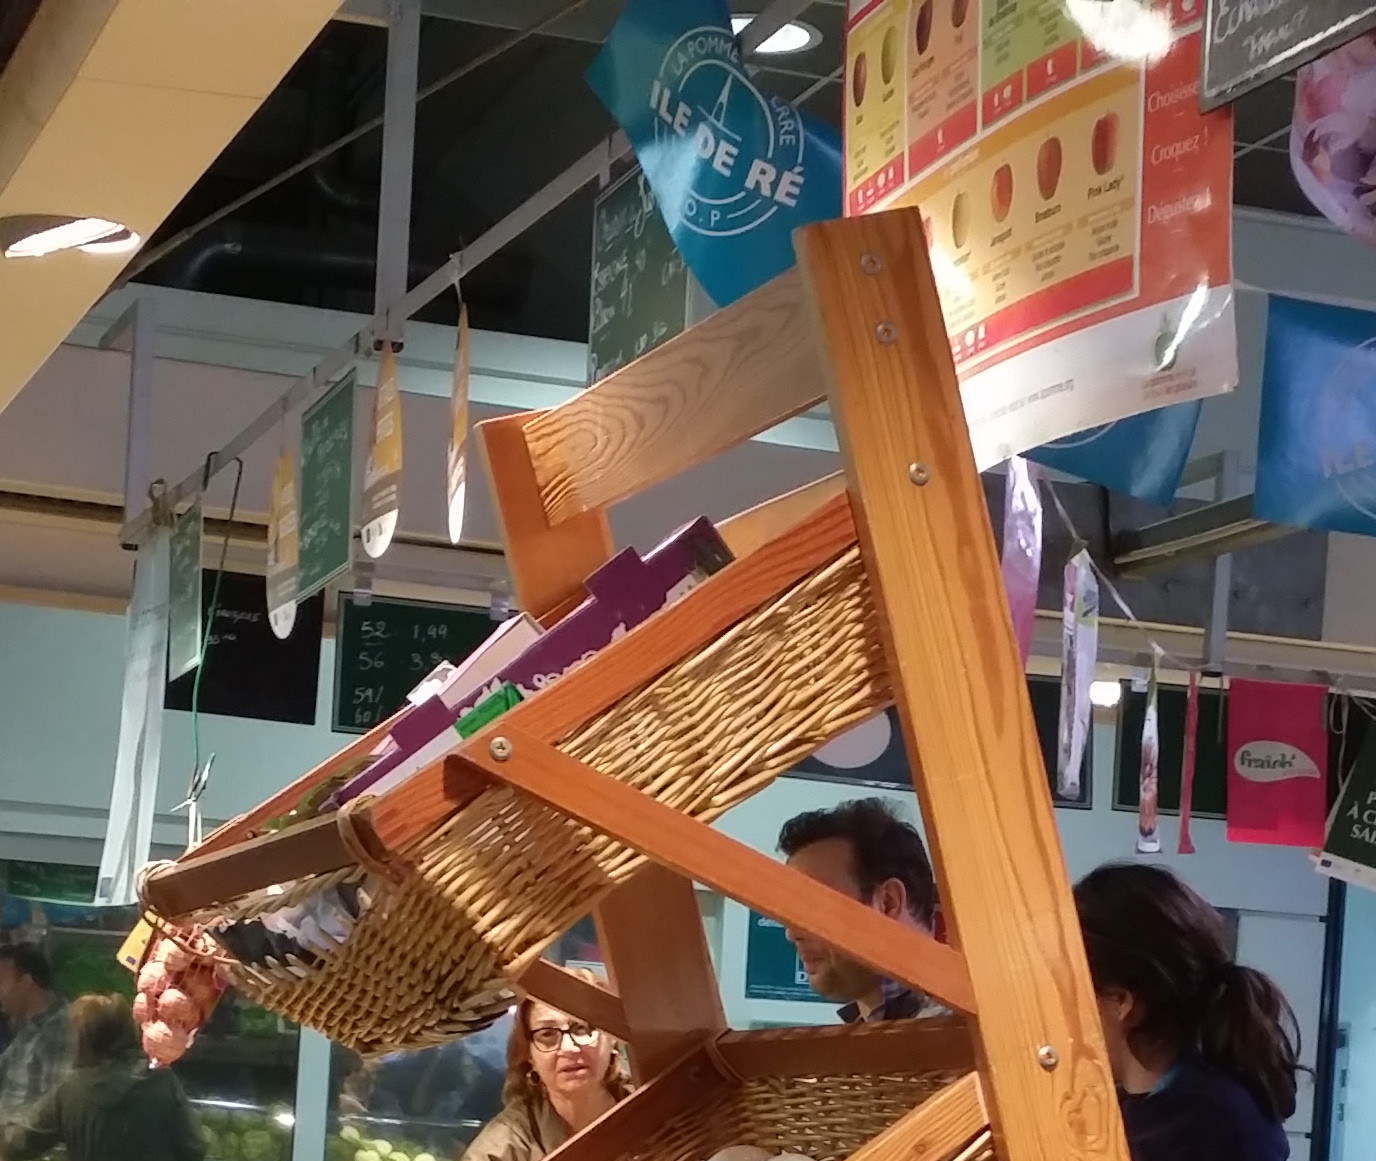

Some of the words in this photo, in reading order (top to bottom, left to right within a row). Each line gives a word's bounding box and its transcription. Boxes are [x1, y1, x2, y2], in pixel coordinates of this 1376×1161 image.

[650, 80, 693, 138] ILE
[694, 121, 740, 178] DE
[744, 158, 805, 208] RÉ
[360, 620, 391, 640] 52
[359, 653, 386, 671] 56
[1346, 801, 1361, 821] À
